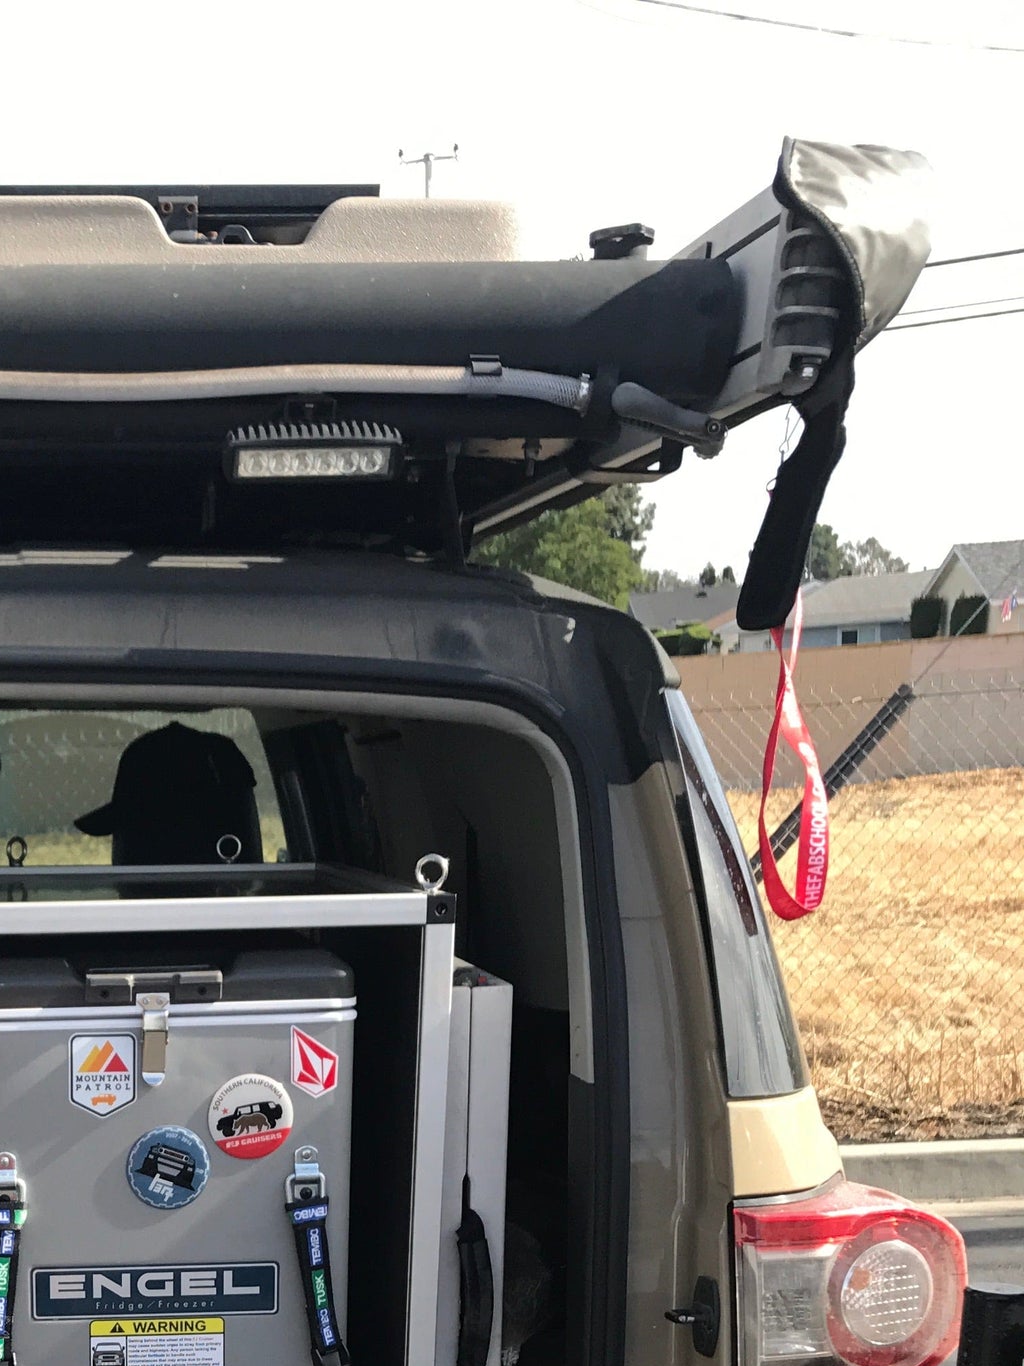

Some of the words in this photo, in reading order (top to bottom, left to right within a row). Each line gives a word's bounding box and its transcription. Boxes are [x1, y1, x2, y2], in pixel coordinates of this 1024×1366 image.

[75, 1074, 131, 1083] MOUNTAIN
[75, 1082, 131, 1091] PATROL
[212, 1080, 243, 1111] SOUTHERN
[243, 1077, 283, 1099] CALIFORNIA
[240, 1132, 283, 1146] CRUISERS
[309, 1228, 322, 1266] TEMBO
[49, 1270, 261, 1299] ENGEL
[314, 1274, 327, 1306] TUSK
[132, 1320, 207, 1334] WARNING
